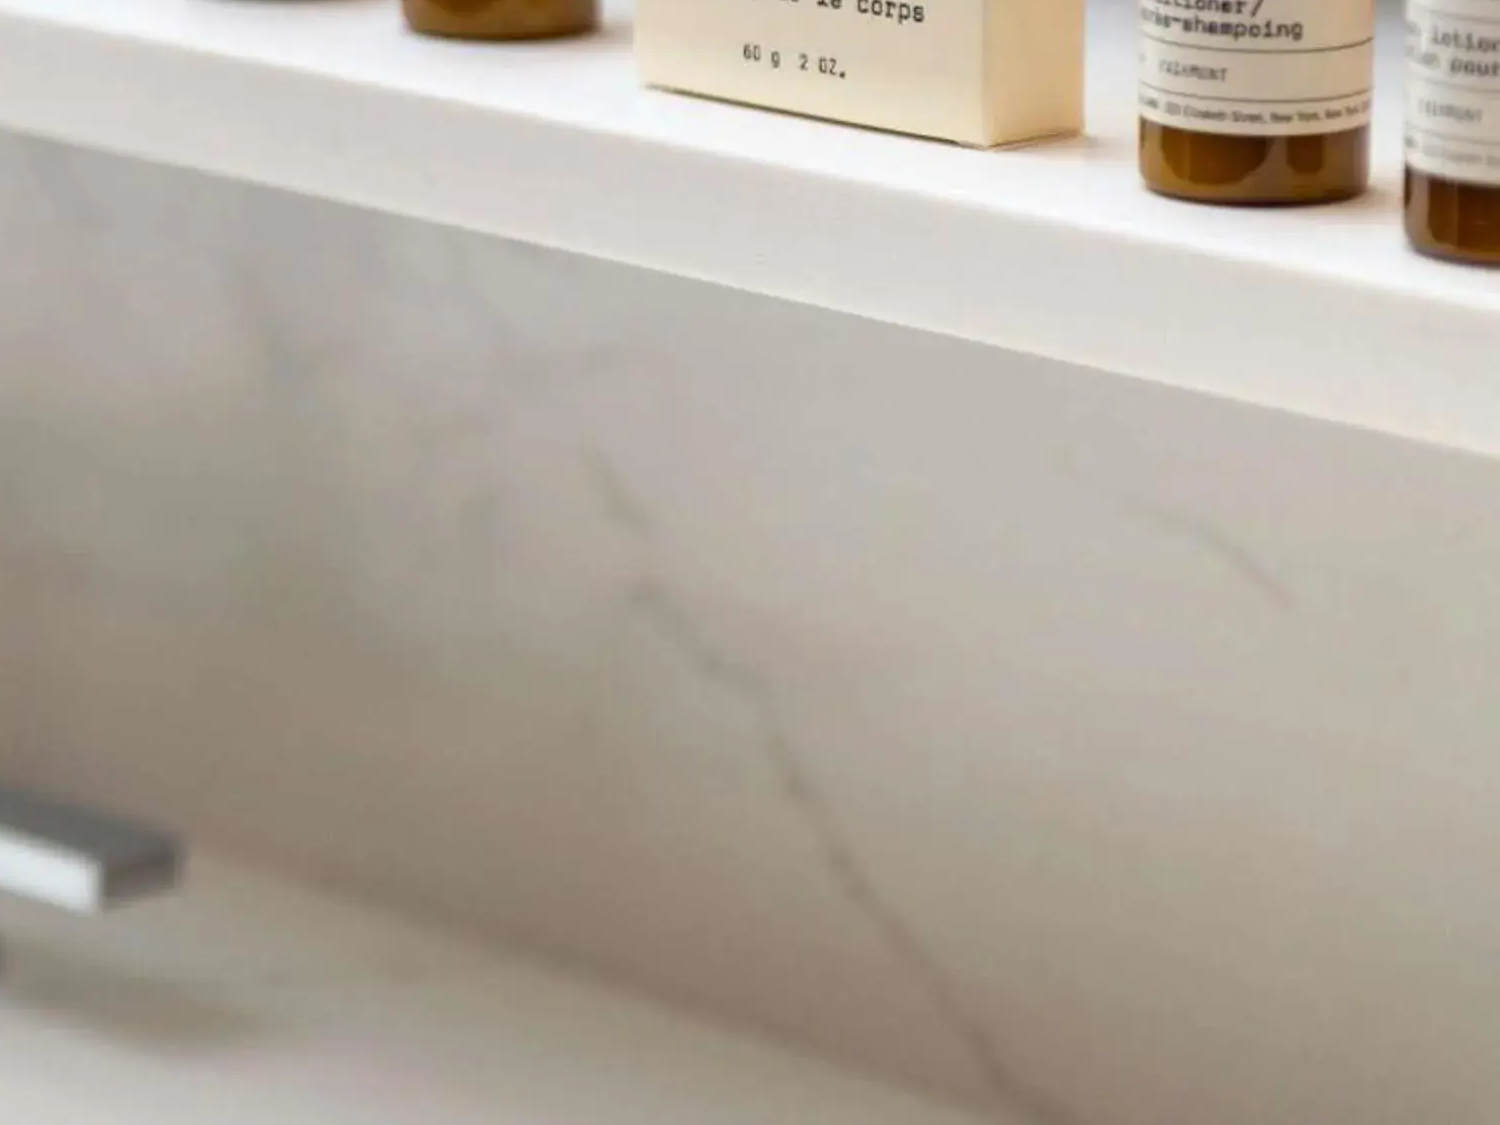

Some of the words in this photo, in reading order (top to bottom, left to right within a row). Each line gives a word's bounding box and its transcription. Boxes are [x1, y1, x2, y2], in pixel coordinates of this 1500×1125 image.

[742, 42, 762, 61] 60
[769, 50, 781, 69] g
[799, 53, 809, 71] 2
